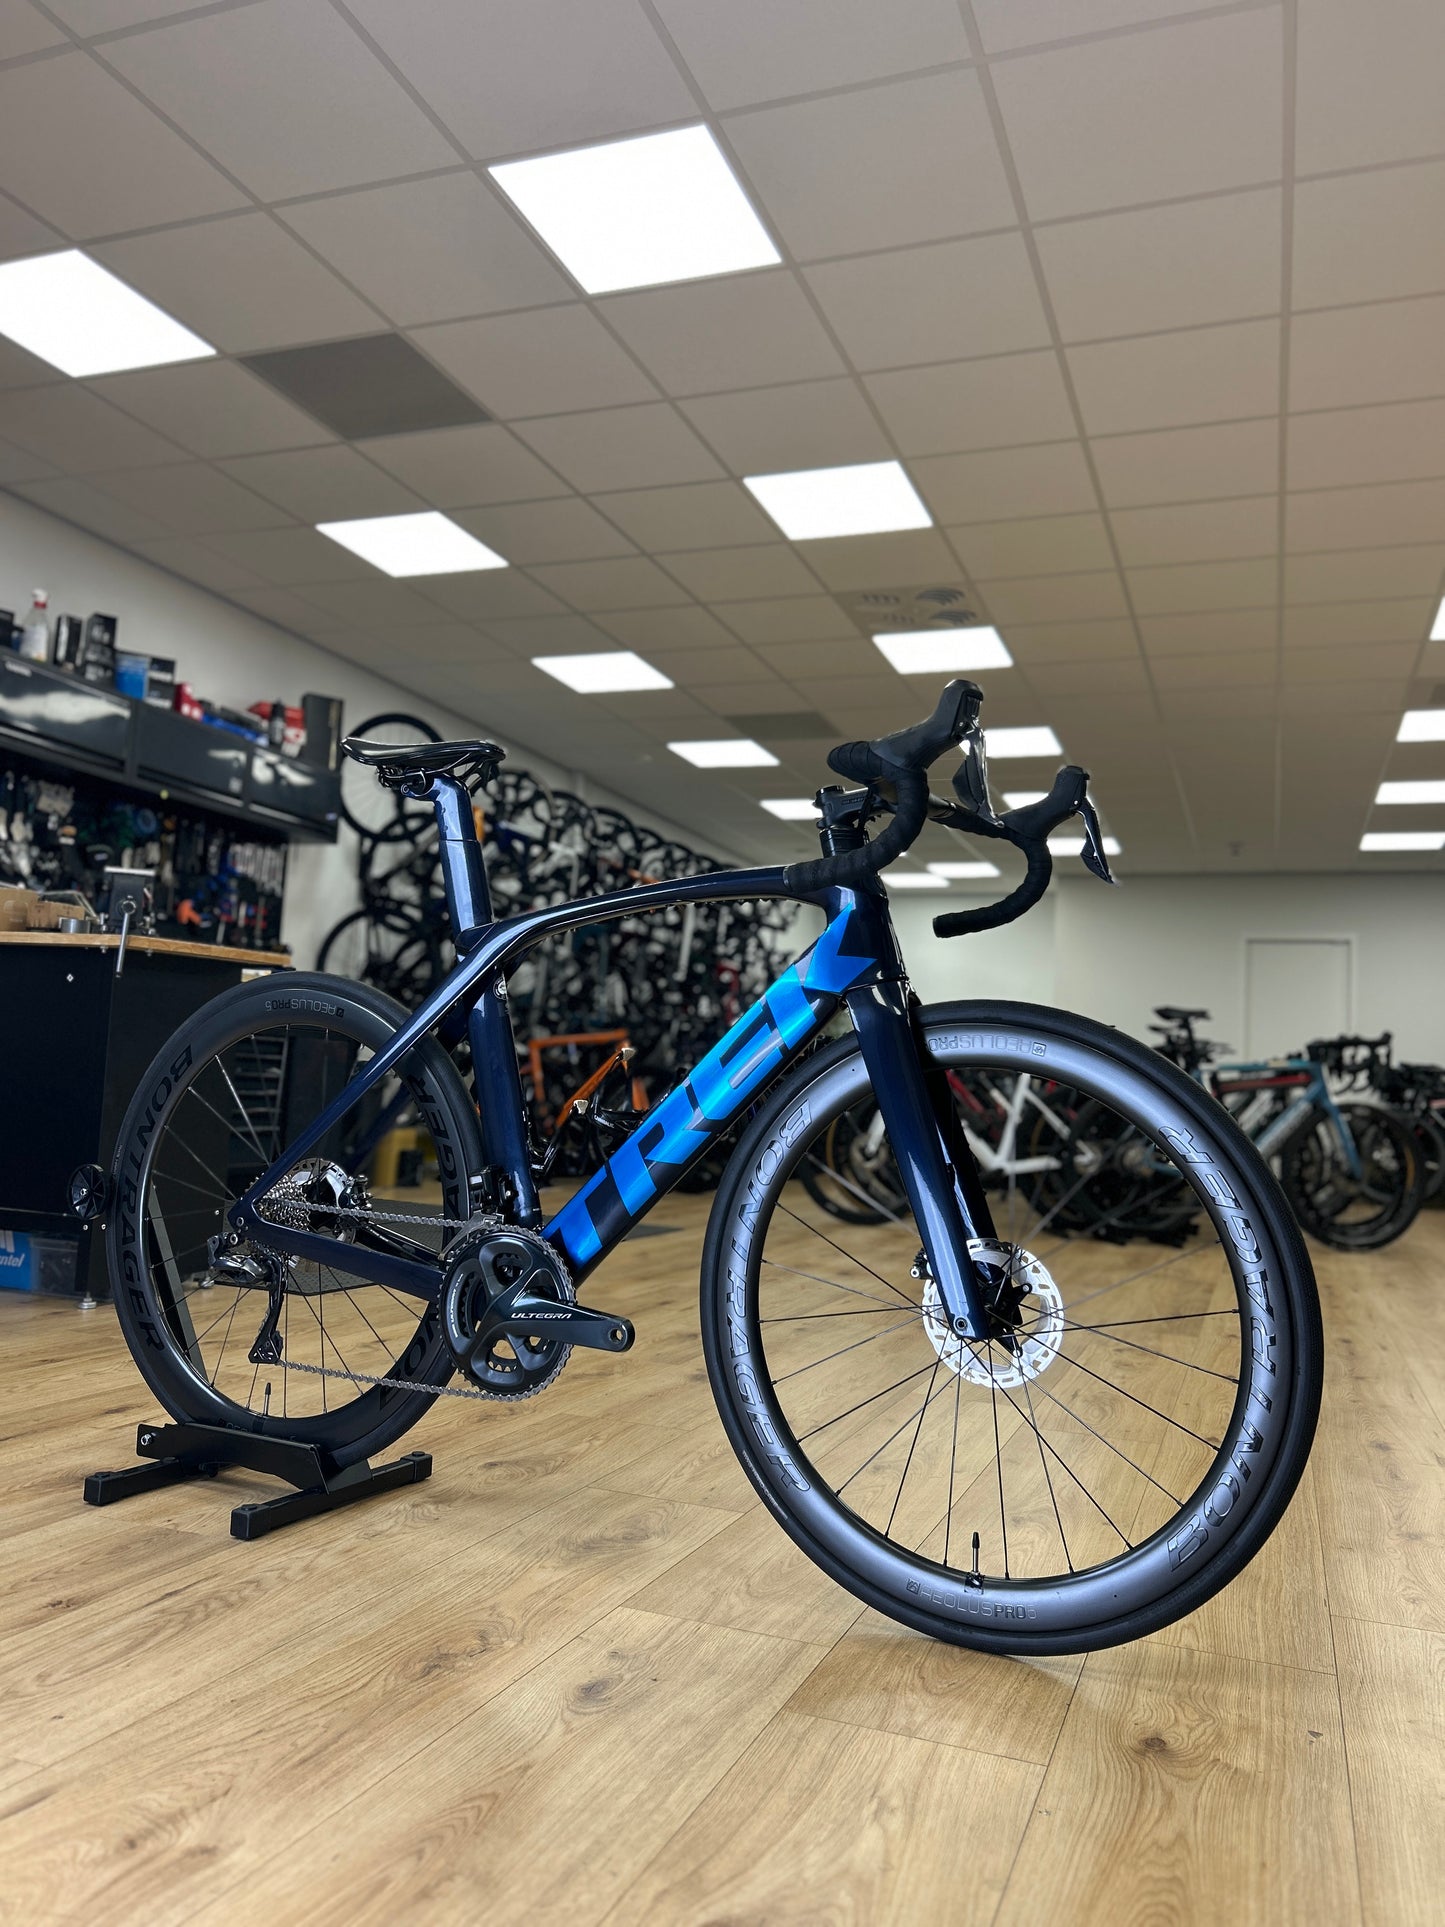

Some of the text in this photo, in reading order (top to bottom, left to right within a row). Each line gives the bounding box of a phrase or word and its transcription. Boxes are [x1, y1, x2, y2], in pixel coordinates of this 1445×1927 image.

[120, 1044, 193, 1351] BONTRAGER
[541, 902, 878, 1269] TREK
[928, 1034, 1032, 1054] AEOLUSPRO
[726, 1098, 812, 1492] BONTRAGER
[1159, 1125, 1277, 1572] BONTRAGER
